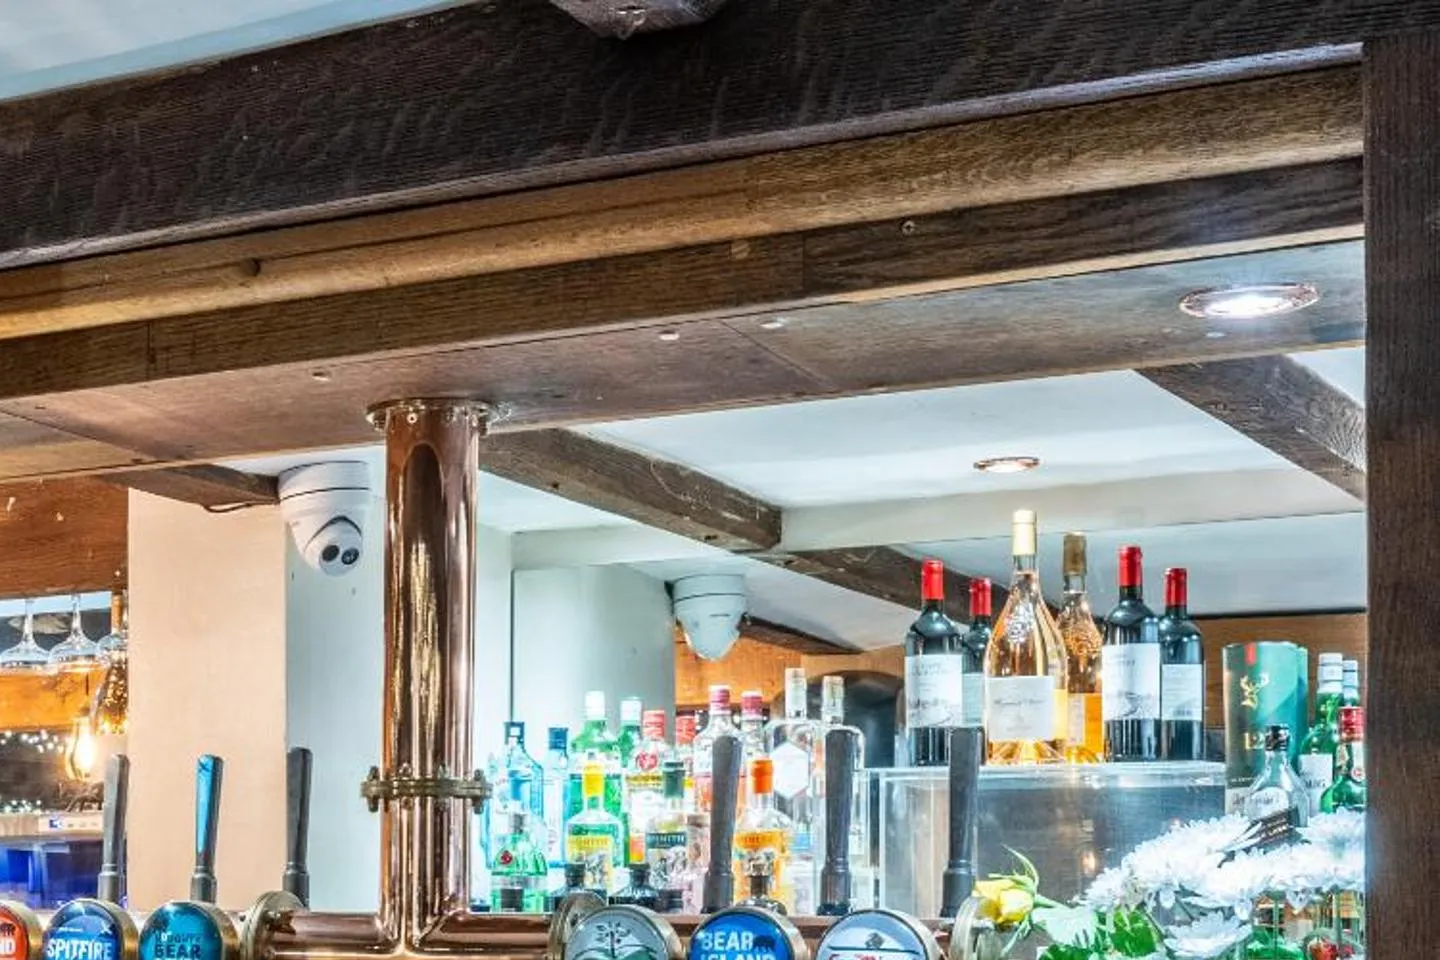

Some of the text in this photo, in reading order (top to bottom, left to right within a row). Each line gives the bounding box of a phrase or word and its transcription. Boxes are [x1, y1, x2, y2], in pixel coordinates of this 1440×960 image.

[47, 938, 112, 960] SPITFIRE
[155, 944, 201, 958] BEAR
[702, 931, 754, 951] BEAR
